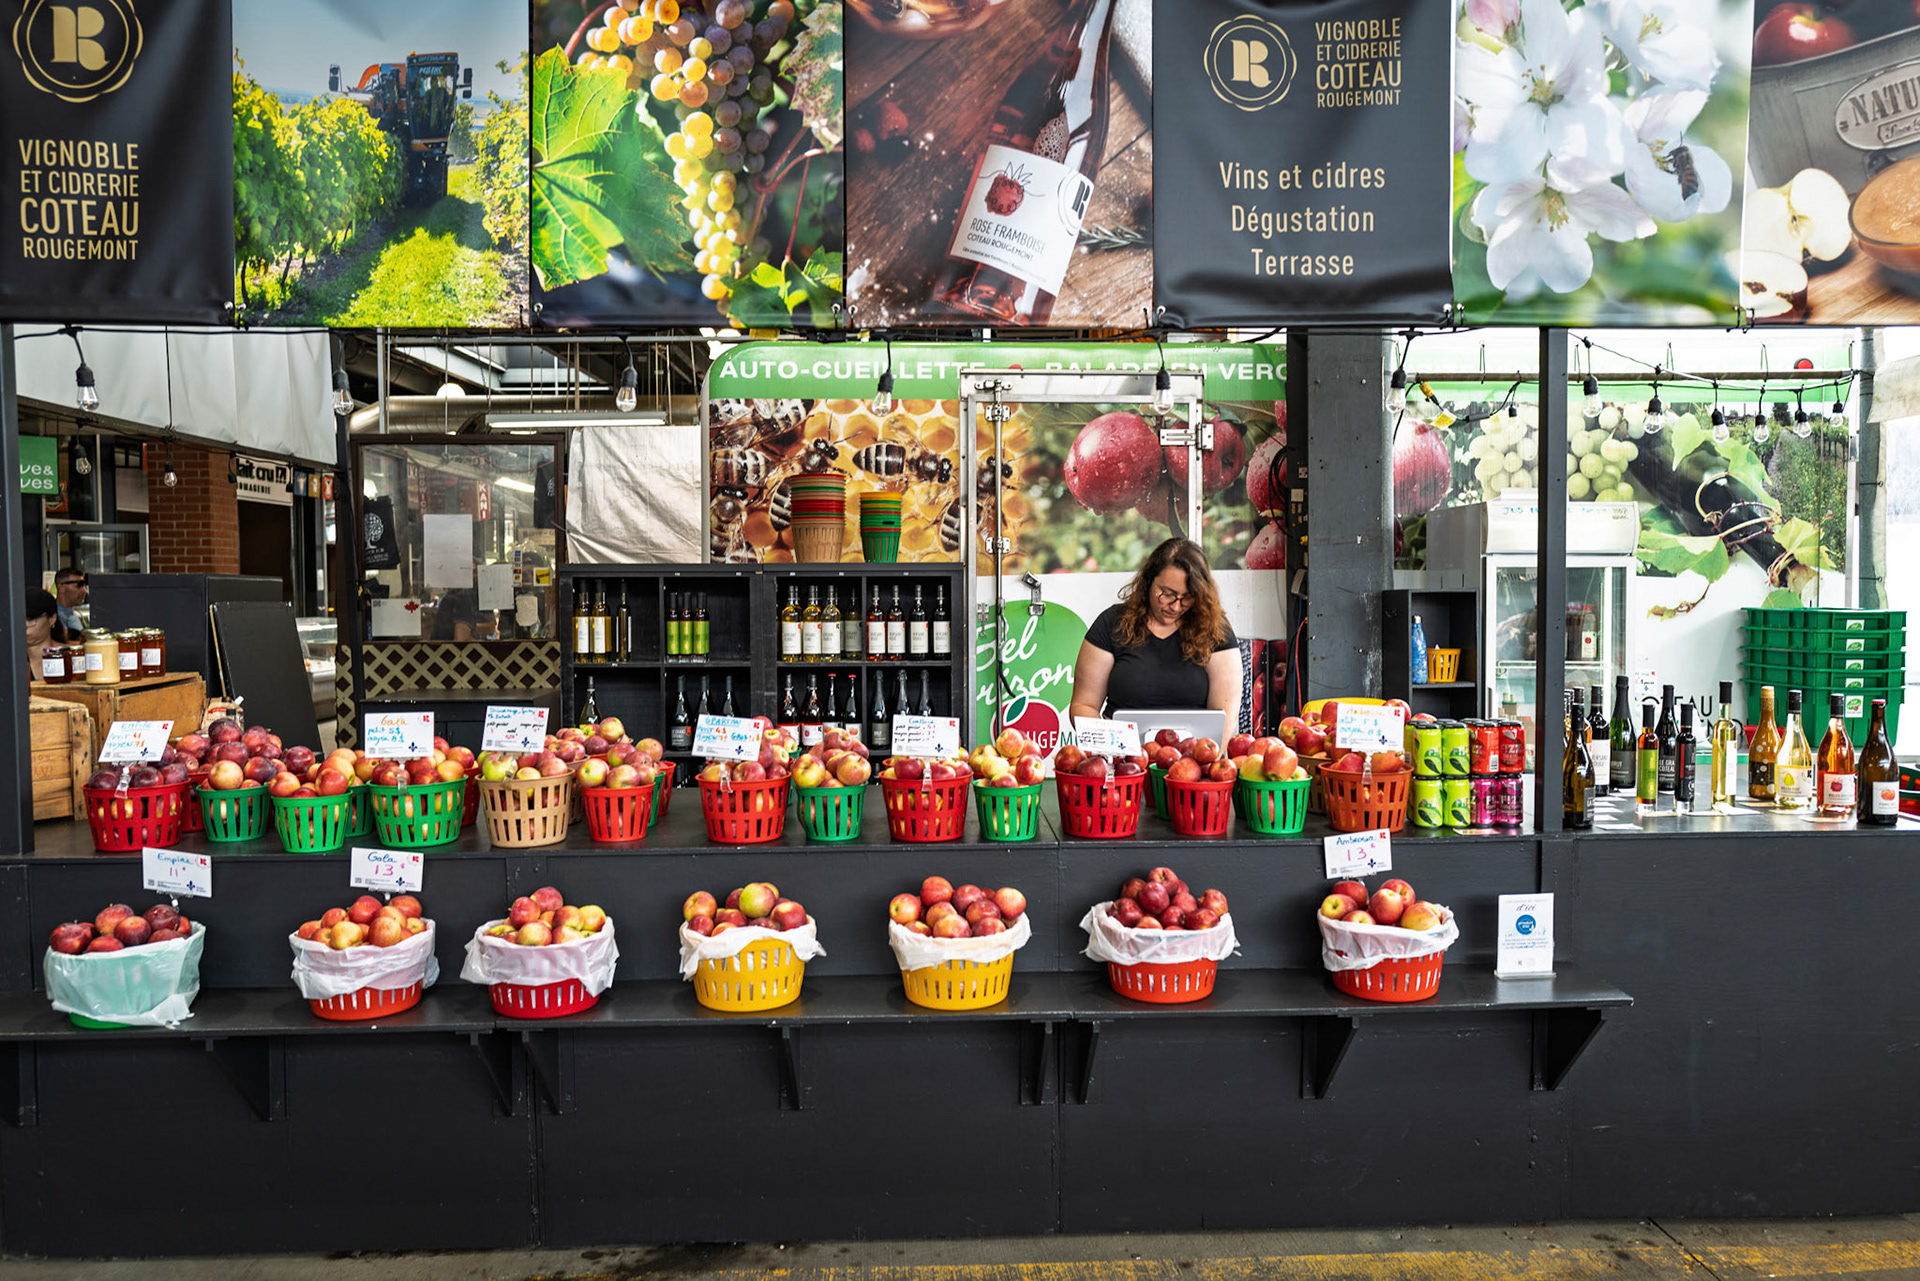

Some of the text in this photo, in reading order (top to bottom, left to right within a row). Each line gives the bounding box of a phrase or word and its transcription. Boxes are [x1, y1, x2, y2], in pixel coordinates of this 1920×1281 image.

[1315, 18, 1401, 41] VIGNOBLE
[1316, 40, 1401, 61] ET CIDRERIE
[1316, 60, 1401, 90] COTEAU
[1317, 89, 1401, 108] ROUGEMONT
[1848, 75, 1920, 126] NATU
[19, 139, 139, 170] VIGNOBLE
[20, 170, 139, 197] ET CIDRERIE
[1219, 161, 1386, 190] Vins et cidres
[20, 197, 139, 236] COTEAU
[1231, 205, 1375, 239] Dégustation
[23, 237, 139, 260] ROUGEMONT
[967, 232, 1034, 261] COTEAU ROUGEMONT
[993, 223, 1047, 255] FRAMBOISE
[1251, 248, 1354, 276] Terrasse
